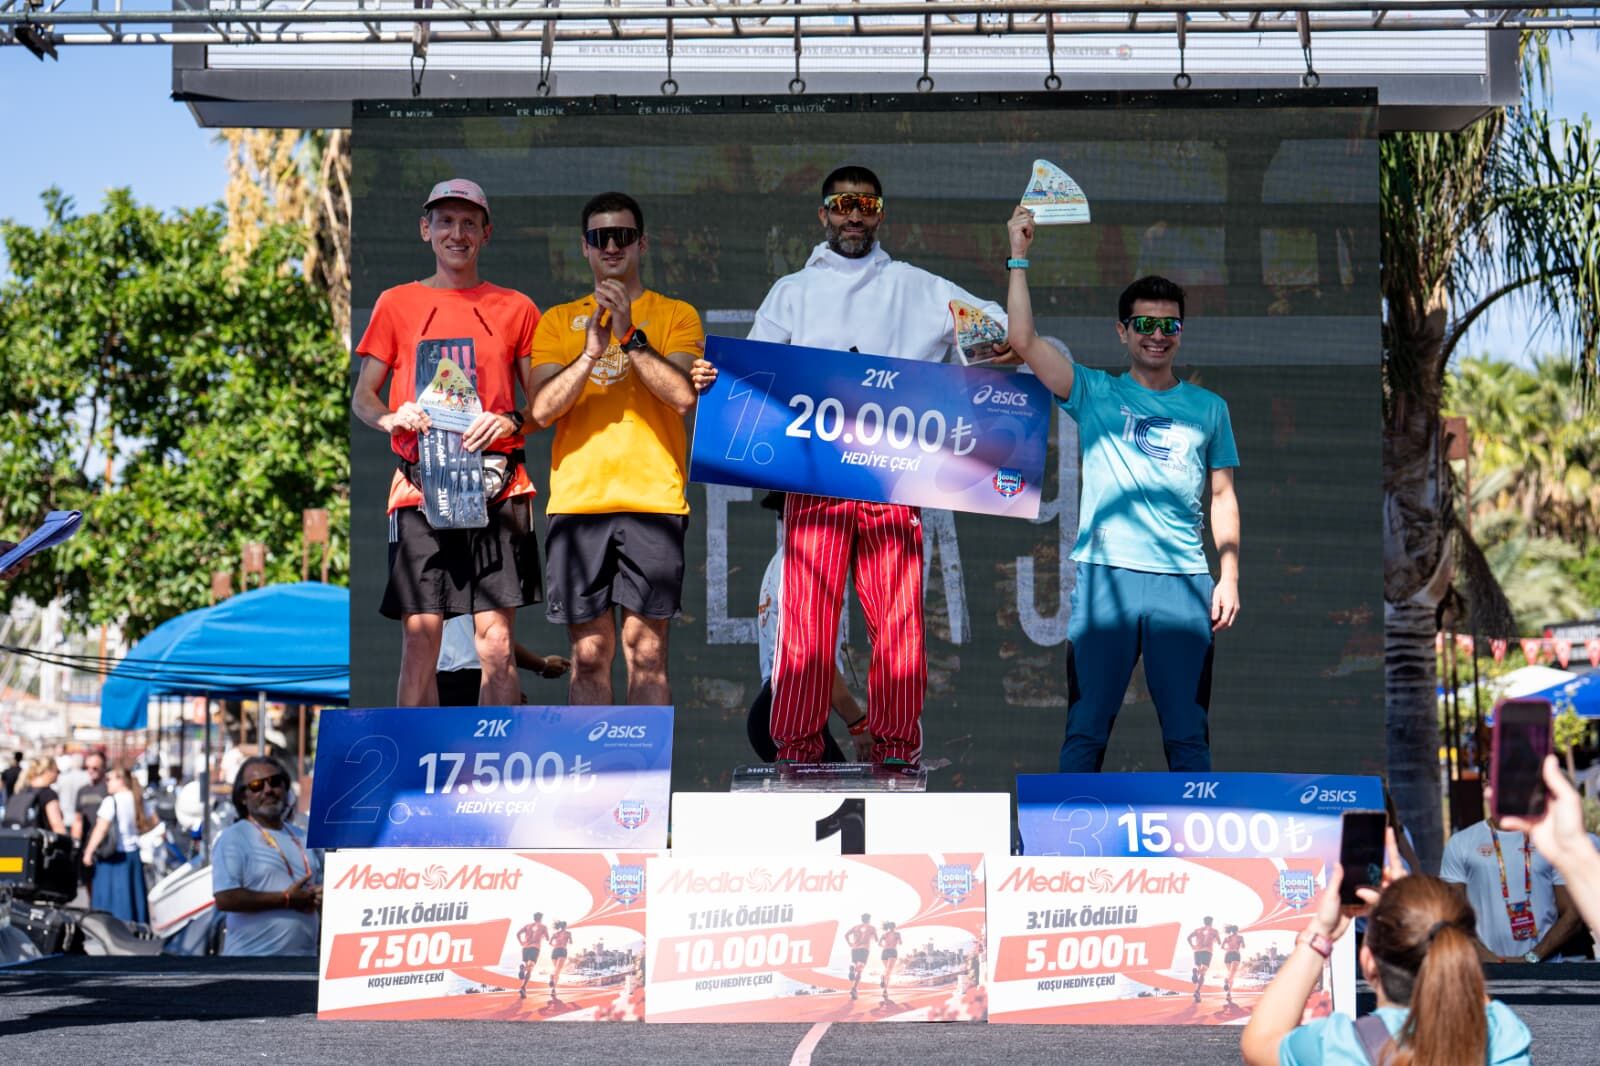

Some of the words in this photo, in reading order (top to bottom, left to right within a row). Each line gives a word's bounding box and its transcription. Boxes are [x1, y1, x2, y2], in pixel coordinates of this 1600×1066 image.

[390, 110, 402, 118] ER
[516, 108, 530, 116] ER
[638, 107, 652, 115] ER
[774, 104, 790, 112] ER
[861, 368, 900, 390] 21K
[840, 451, 889, 469] HEDİYE
[890, 457, 922, 473] ÇEKİ
[473, 720, 512, 738] 21K
[1182, 782, 1219, 800] 21K
[456, 800, 504, 815] HEDİYE
[505, 799, 538, 816] ÇEKİ
[816, 798, 866, 856] 1
[333, 864, 420, 890] Media
[444, 864, 523, 890] Markt
[657, 868, 744, 894] Media
[769, 866, 848, 892] Markt
[996, 867, 1084, 894] Media
[1110, 868, 1190, 894] Markt
[412, 901, 469, 925] Ödülü
[735, 904, 794, 927] Ödülü
[1079, 904, 1138, 926] Ödülü
[368, 976, 393, 988] KOŞU
[393, 974, 424, 987] HEDİYE
[425, 972, 444, 986] ÇEKİ
[695, 978, 720, 991] KOŞU
[720, 976, 752, 989] HEDİYE
[752, 974, 773, 989] ÇEKİ
[1037, 978, 1062, 992] KOŞU
[1062, 976, 1094, 989] HEDİYE
[1095, 974, 1116, 988] ÇEKİ
